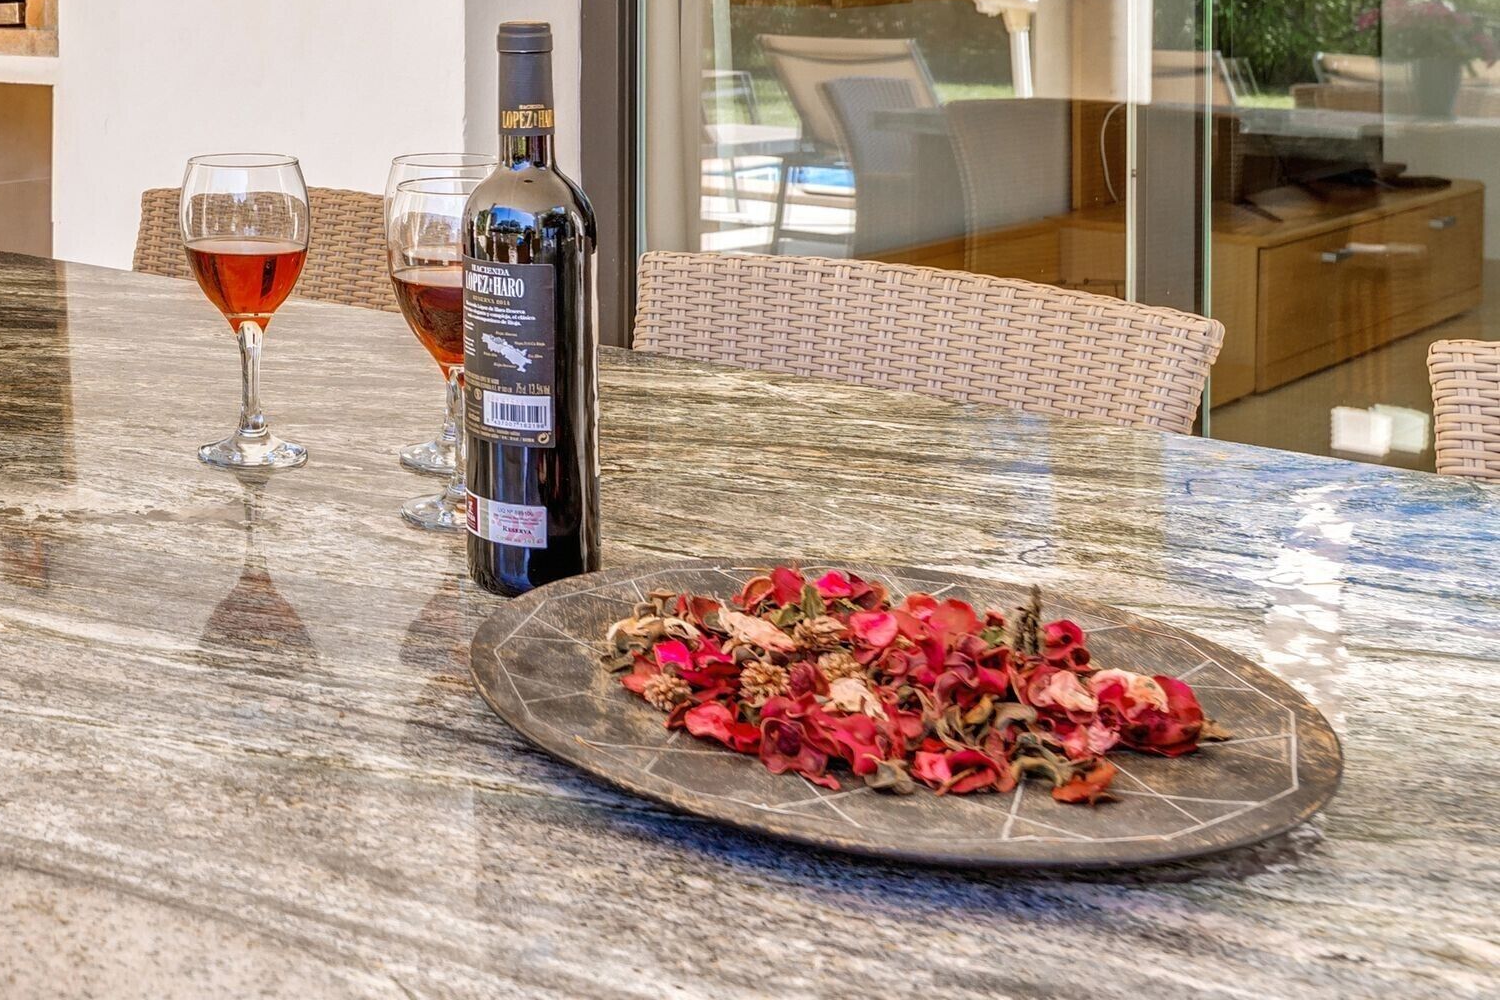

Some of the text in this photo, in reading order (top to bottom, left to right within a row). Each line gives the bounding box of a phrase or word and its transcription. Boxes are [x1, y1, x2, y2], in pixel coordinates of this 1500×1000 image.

[502, 110, 533, 129] LOPEZ
[471, 264, 510, 276] HACIENDA
[465, 270, 489, 294] LOPEZ
[493, 276, 525, 298] HARO
